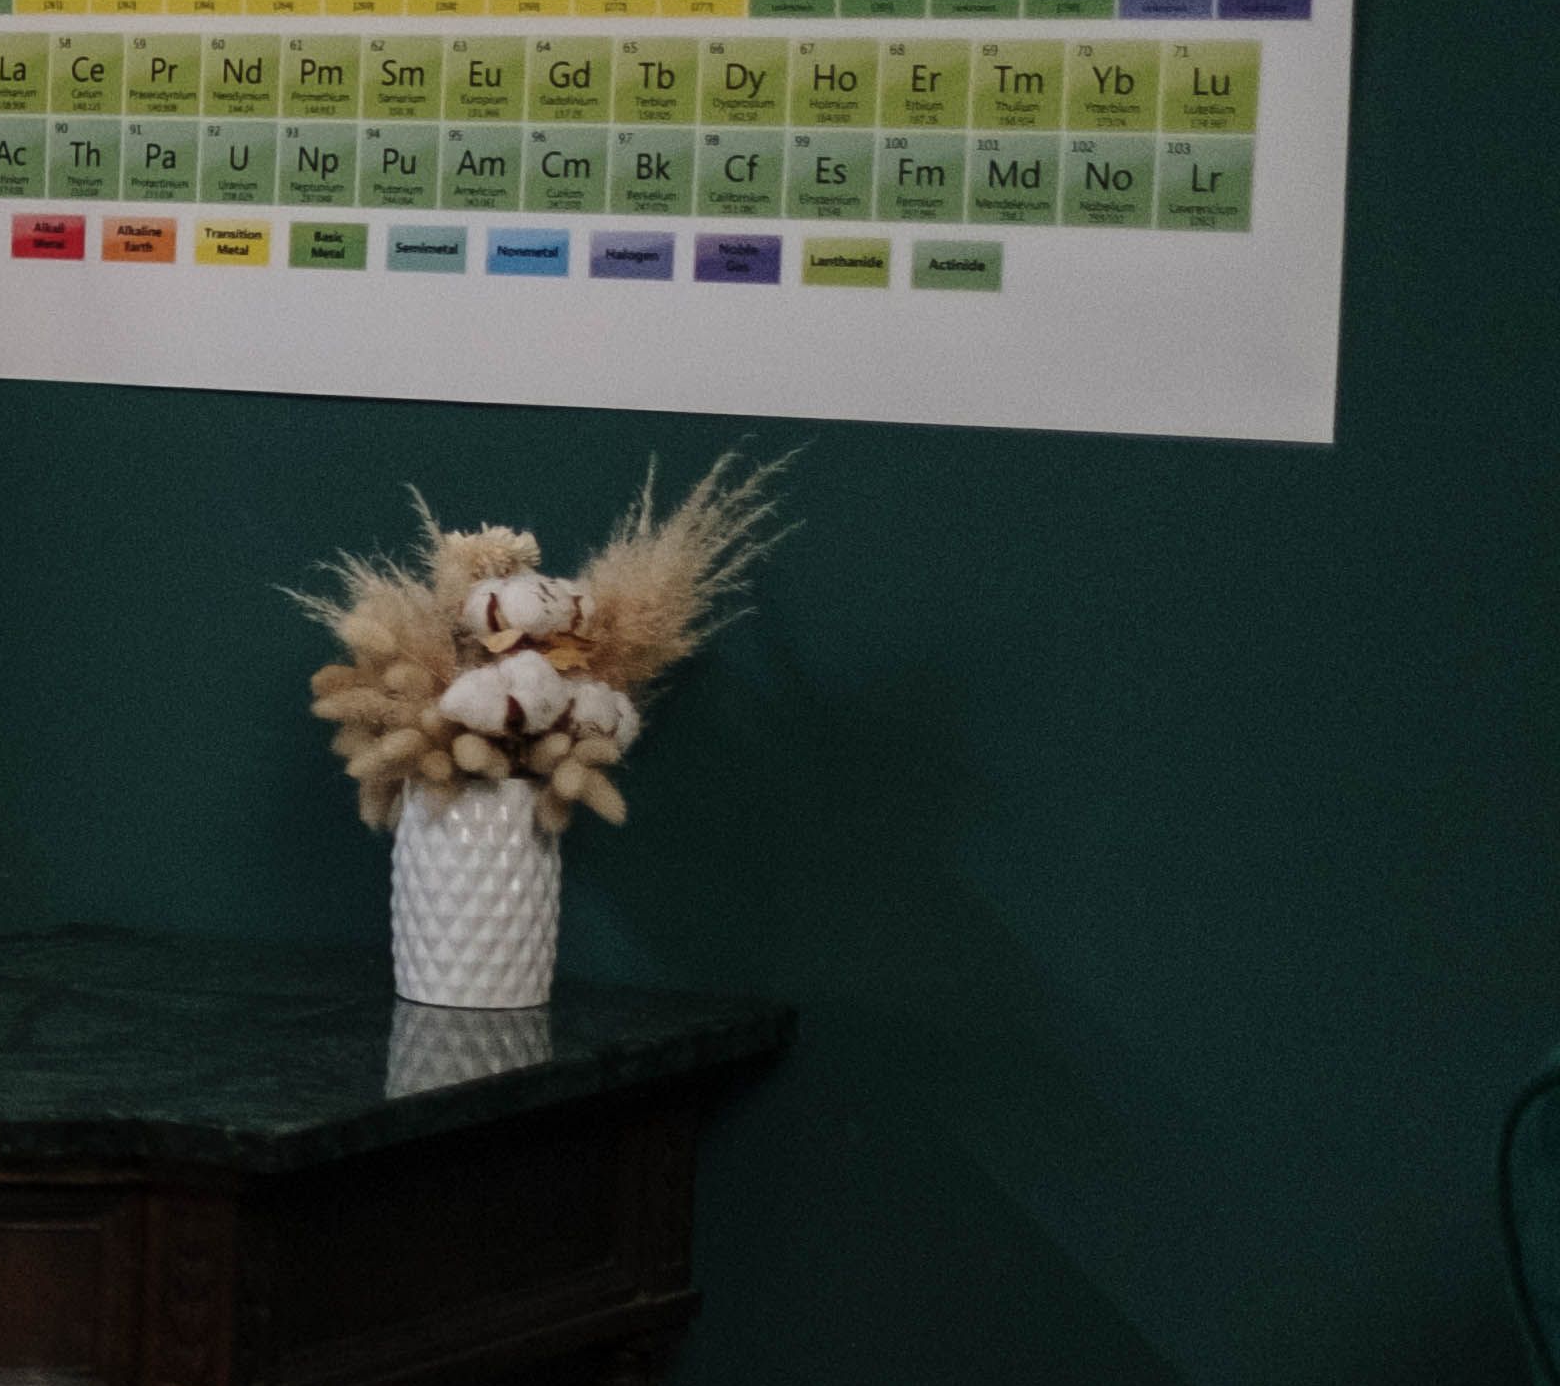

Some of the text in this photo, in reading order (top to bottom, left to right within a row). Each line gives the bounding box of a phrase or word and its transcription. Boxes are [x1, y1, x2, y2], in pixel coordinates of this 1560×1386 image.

[0, 58, 28, 82] La
[1193, 67, 1231, 97] Lu
[1192, 163, 1222, 194] Lr
[117, 226, 162, 239] Alkaline
[205, 228, 263, 242] Transition
[315, 230, 343, 245] Basic
[124, 241, 154, 255] Earth
[217, 244, 249, 259] Metal
[311, 247, 345, 261] Metal
[395, 241, 459, 257] Semimetal
[497, 245, 559, 261] Nonmetal
[606, 248, 660, 265] Halogen
[810, 255, 883, 271] Lanthanide
[929, 258, 986, 274] Actinide
